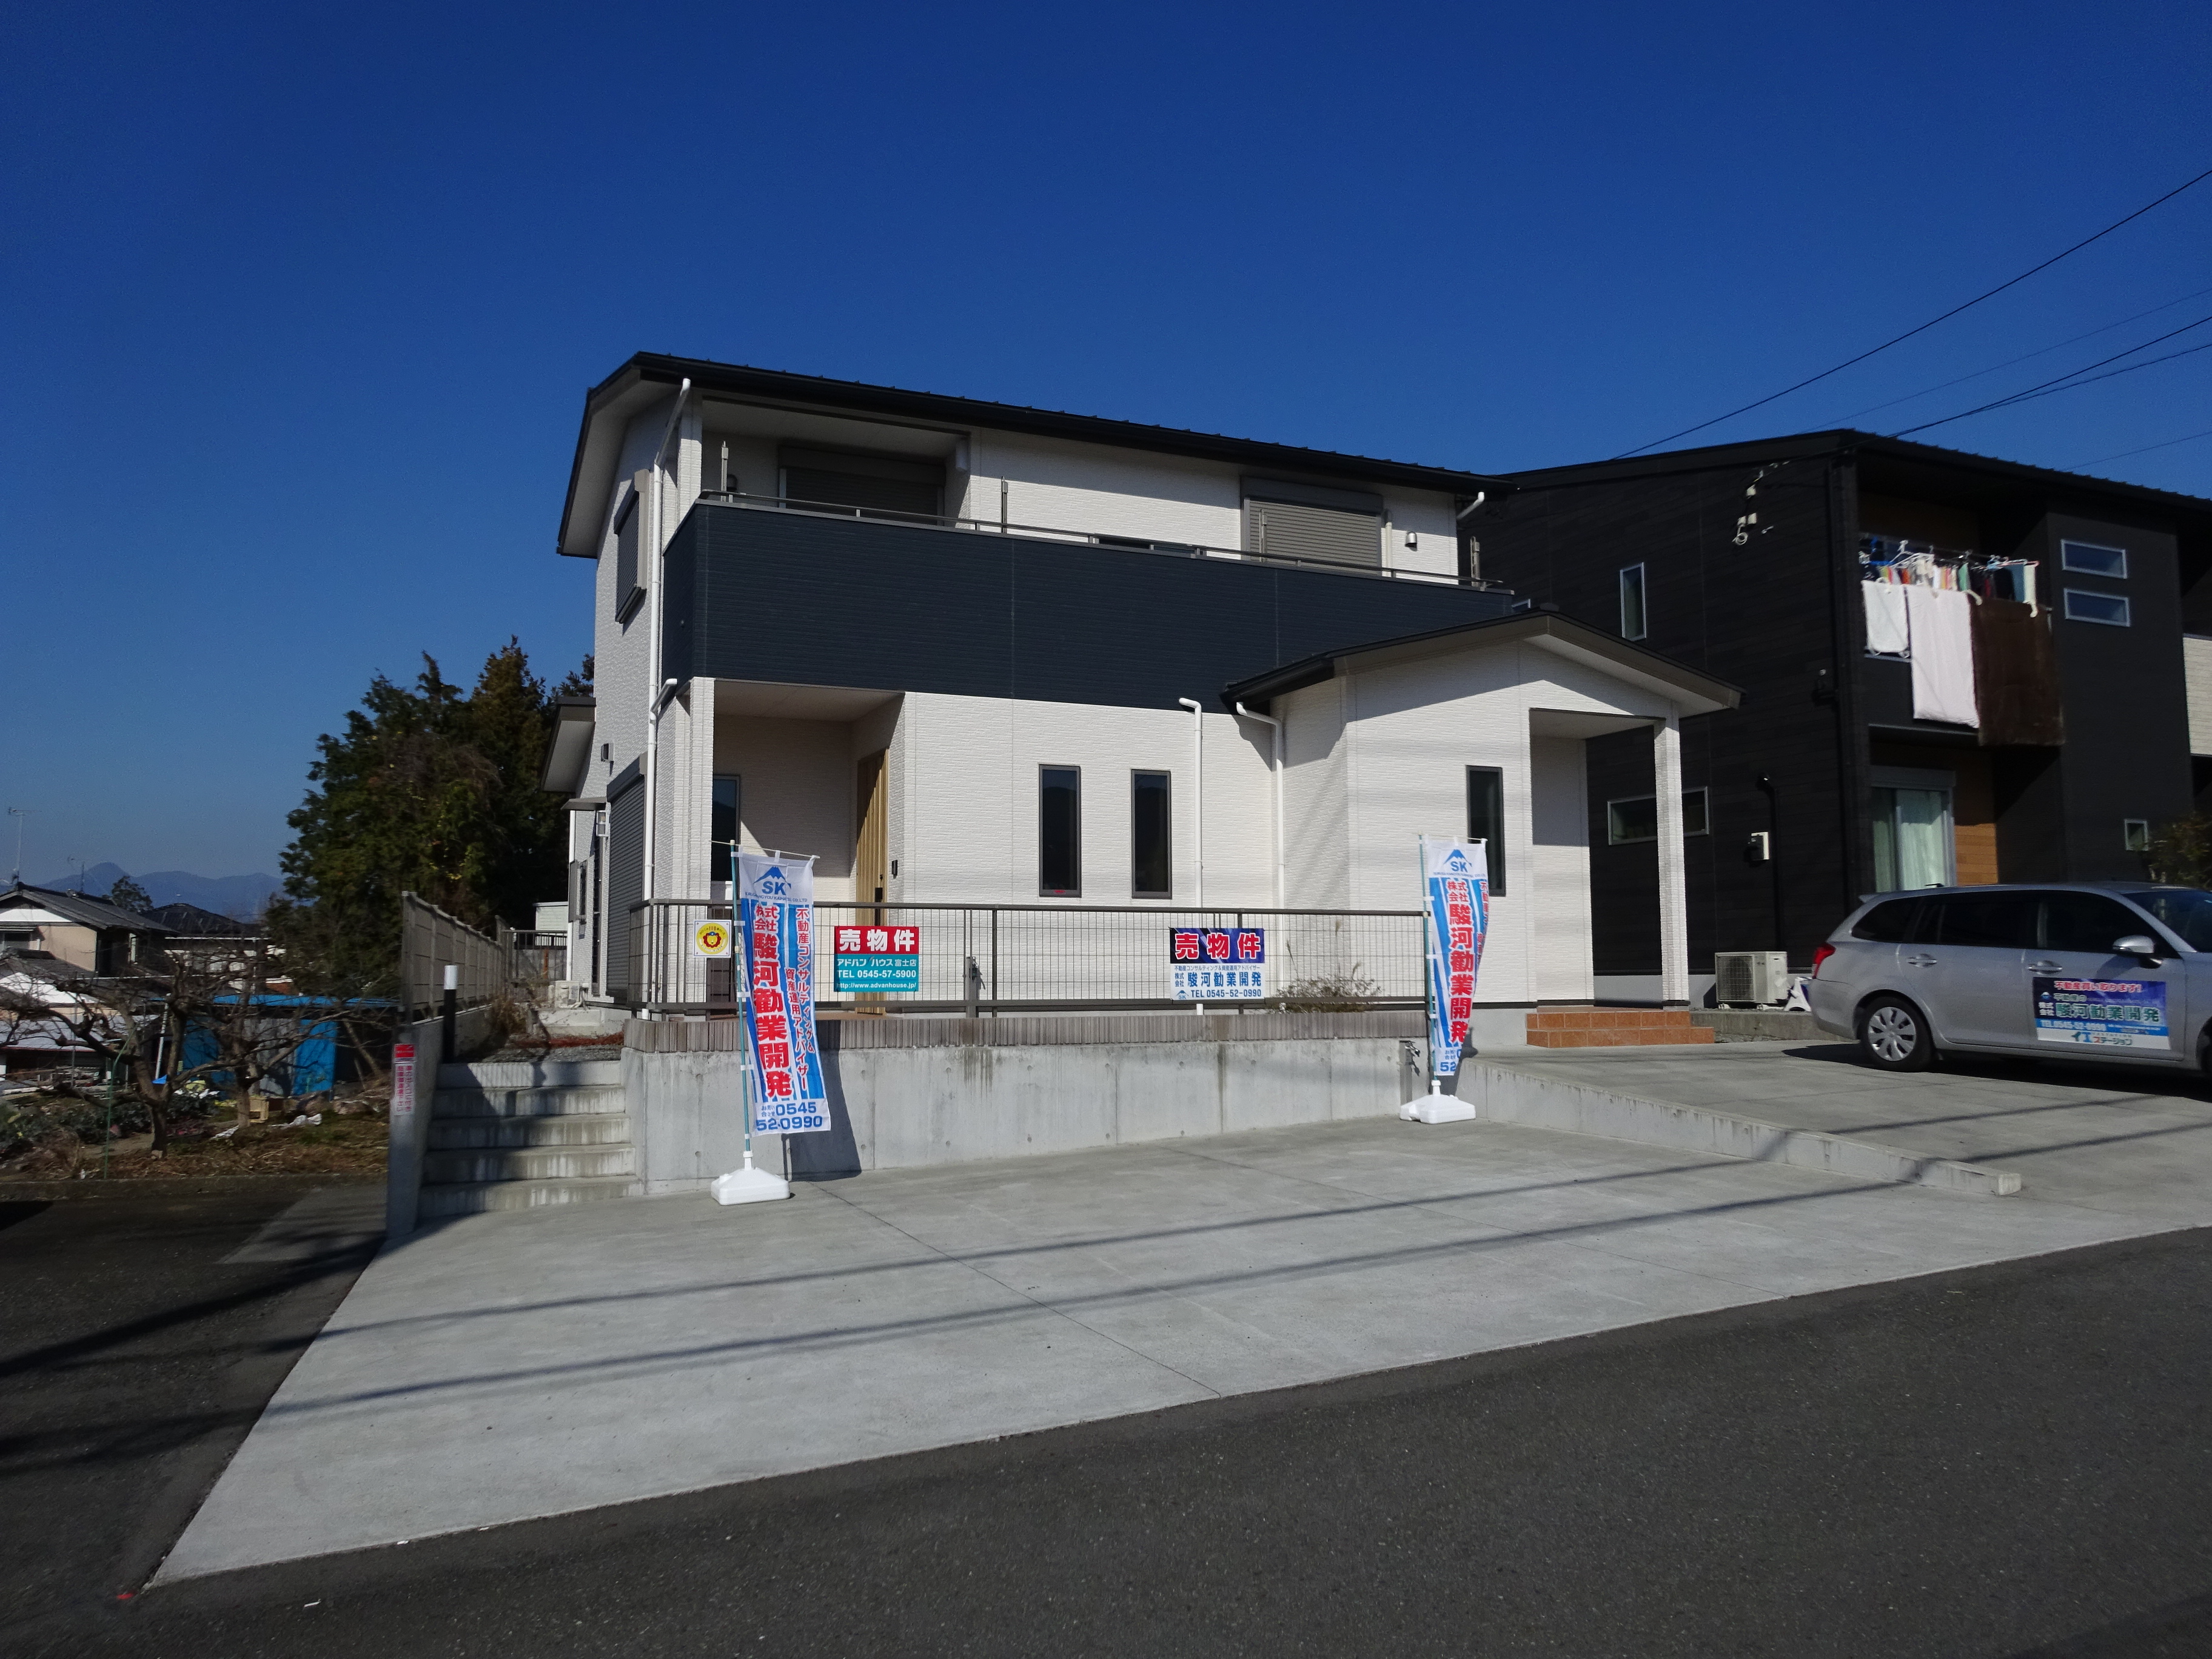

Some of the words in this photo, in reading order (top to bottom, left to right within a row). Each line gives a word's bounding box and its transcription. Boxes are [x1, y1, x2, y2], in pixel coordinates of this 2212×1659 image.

[1450, 861, 1468, 873] SK
[762, 880, 786, 896] SK
[755, 905, 778, 919] 株式
[754, 919, 777, 932] 会社
[839, 928, 916, 952] 売物件
[1175, 932, 1261, 960] 売物件
[837, 970, 855, 978] TEL
[857, 970, 917, 978] 0545-57-5900
[1187, 971, 1262, 987] 駿河勧業開発
[1190, 990, 1205, 998] TEL
[1206, 989, 1262, 998] 0545-52-0990
[753, 933, 793, 1098] 駿河勧業開発
[2055, 1002, 2160, 1023] 駿河勧業開発
[785, 969, 808, 1090] 資産運用アドバイザー
[776, 1101, 817, 1116] 0545
